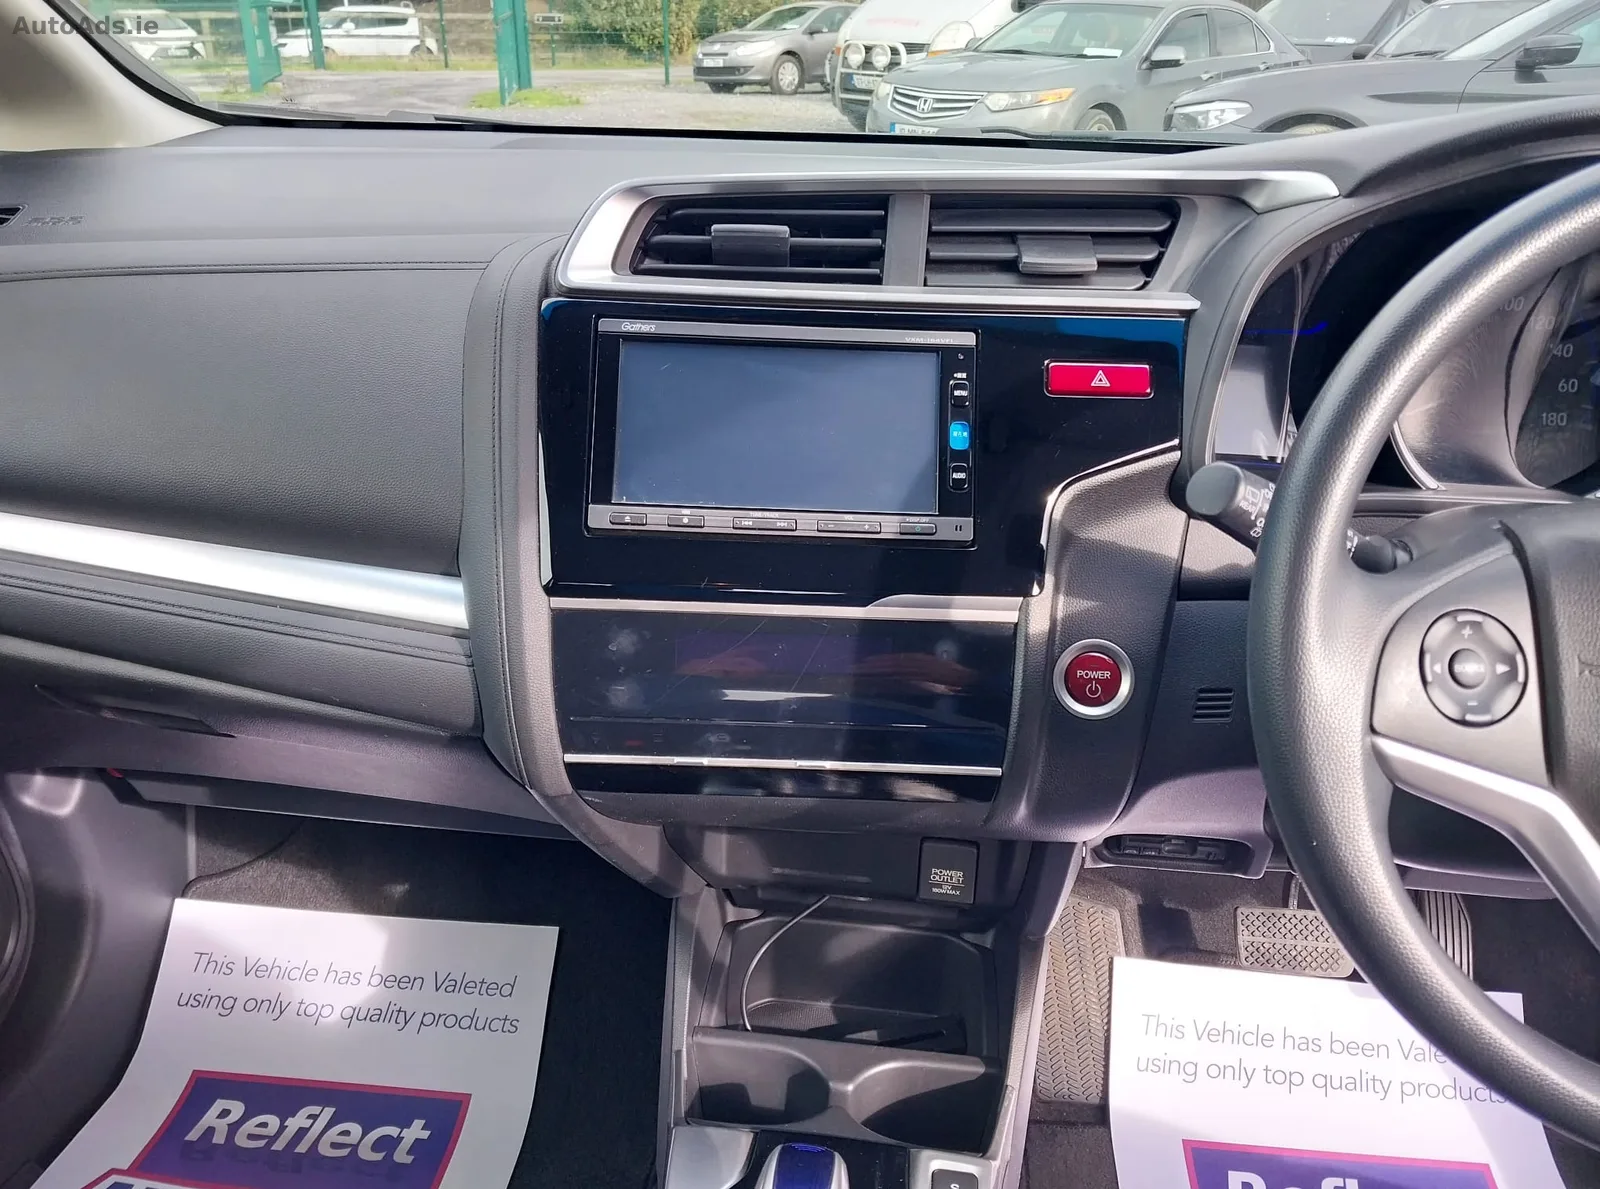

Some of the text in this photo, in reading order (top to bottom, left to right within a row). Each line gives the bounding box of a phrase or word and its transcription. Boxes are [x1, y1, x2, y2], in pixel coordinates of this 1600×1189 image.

[621, 321, 657, 332] Gathers
[1541, 412, 1568, 426] 180
[1076, 669, 1111, 680] POWER
[930, 874, 965, 884] OUTLET
[931, 868, 964, 878] POWER
[193, 951, 518, 998] This Vehicle has been Valeted
[177, 988, 520, 1035] using only top quality products
[1141, 1013, 1447, 1064] This Vehicle has been Vale
[1136, 1052, 1199, 1084] using
[1206, 1057, 1257, 1089] only
[1262, 1064, 1305, 1095] top
[1312, 1069, 1393, 1101] quality
[184, 1098, 432, 1164] Reflect
